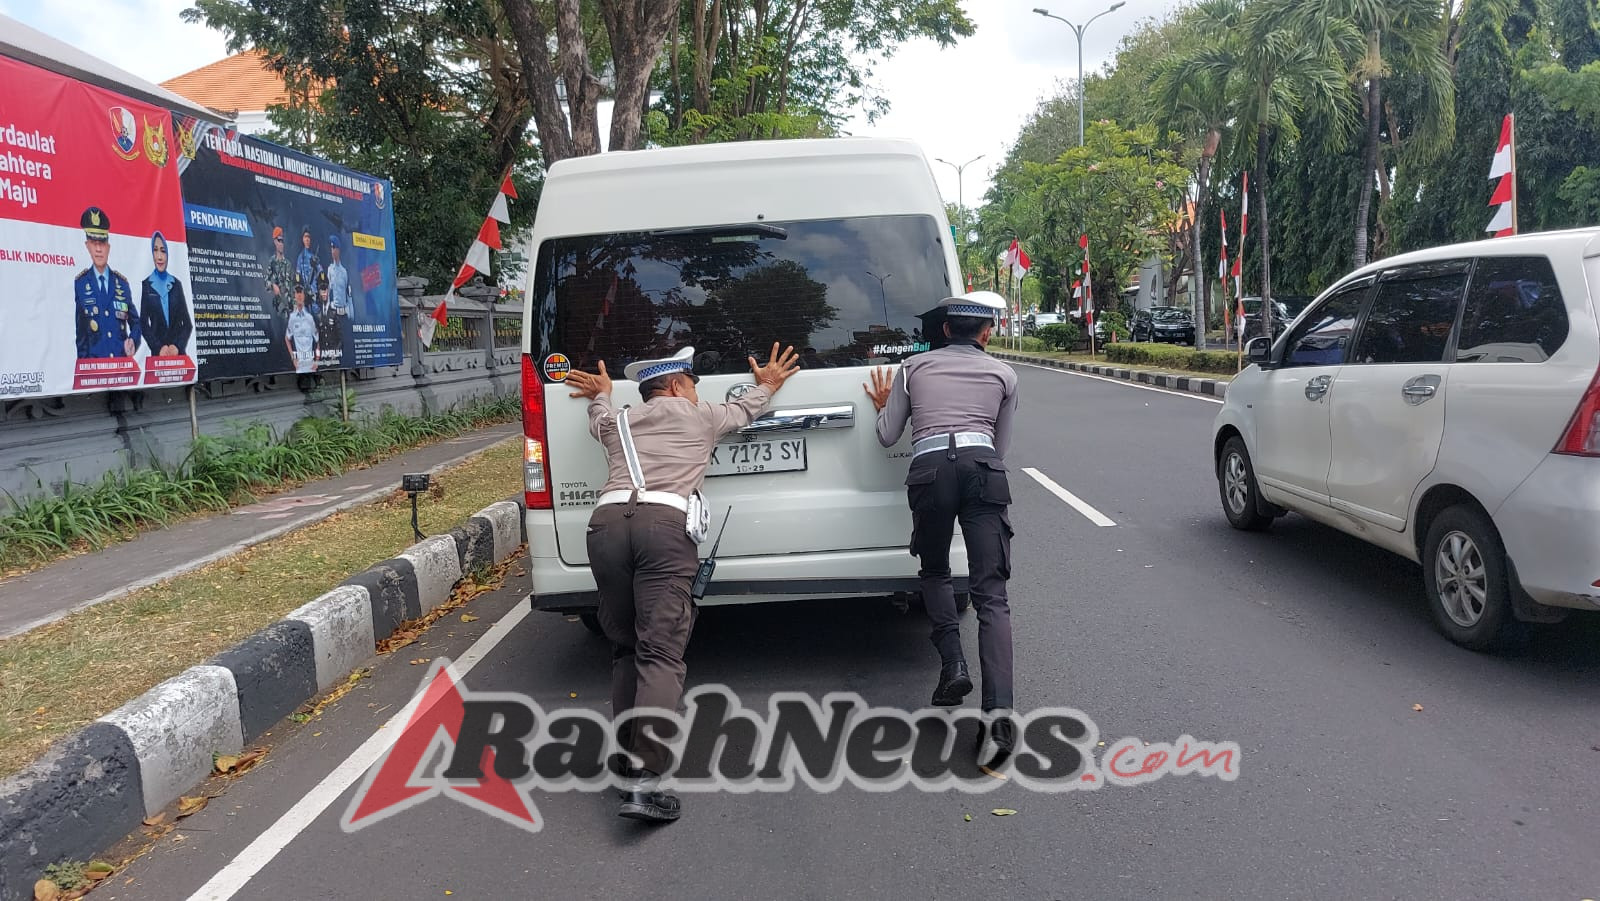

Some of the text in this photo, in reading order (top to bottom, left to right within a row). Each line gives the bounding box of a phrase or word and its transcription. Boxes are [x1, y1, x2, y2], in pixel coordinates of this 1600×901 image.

[204, 133, 244, 157] TENTARA
[245, 145, 284, 169] NASIONAL
[283, 155, 320, 180] INDONESIA
[320, 168, 352, 189] ANGKATAN
[352, 178, 371, 194] UDARA
[0, 178, 37, 208] Maju
[190, 210, 248, 232] PENDAFTARAN
[25, 251, 75, 266] INDONESIA
[873, 341, 930, 355] #KangenBali
[1, 371, 44, 385] AMPUH
[729, 443, 772, 463] 7173
[781, 441, 801, 460] SY
